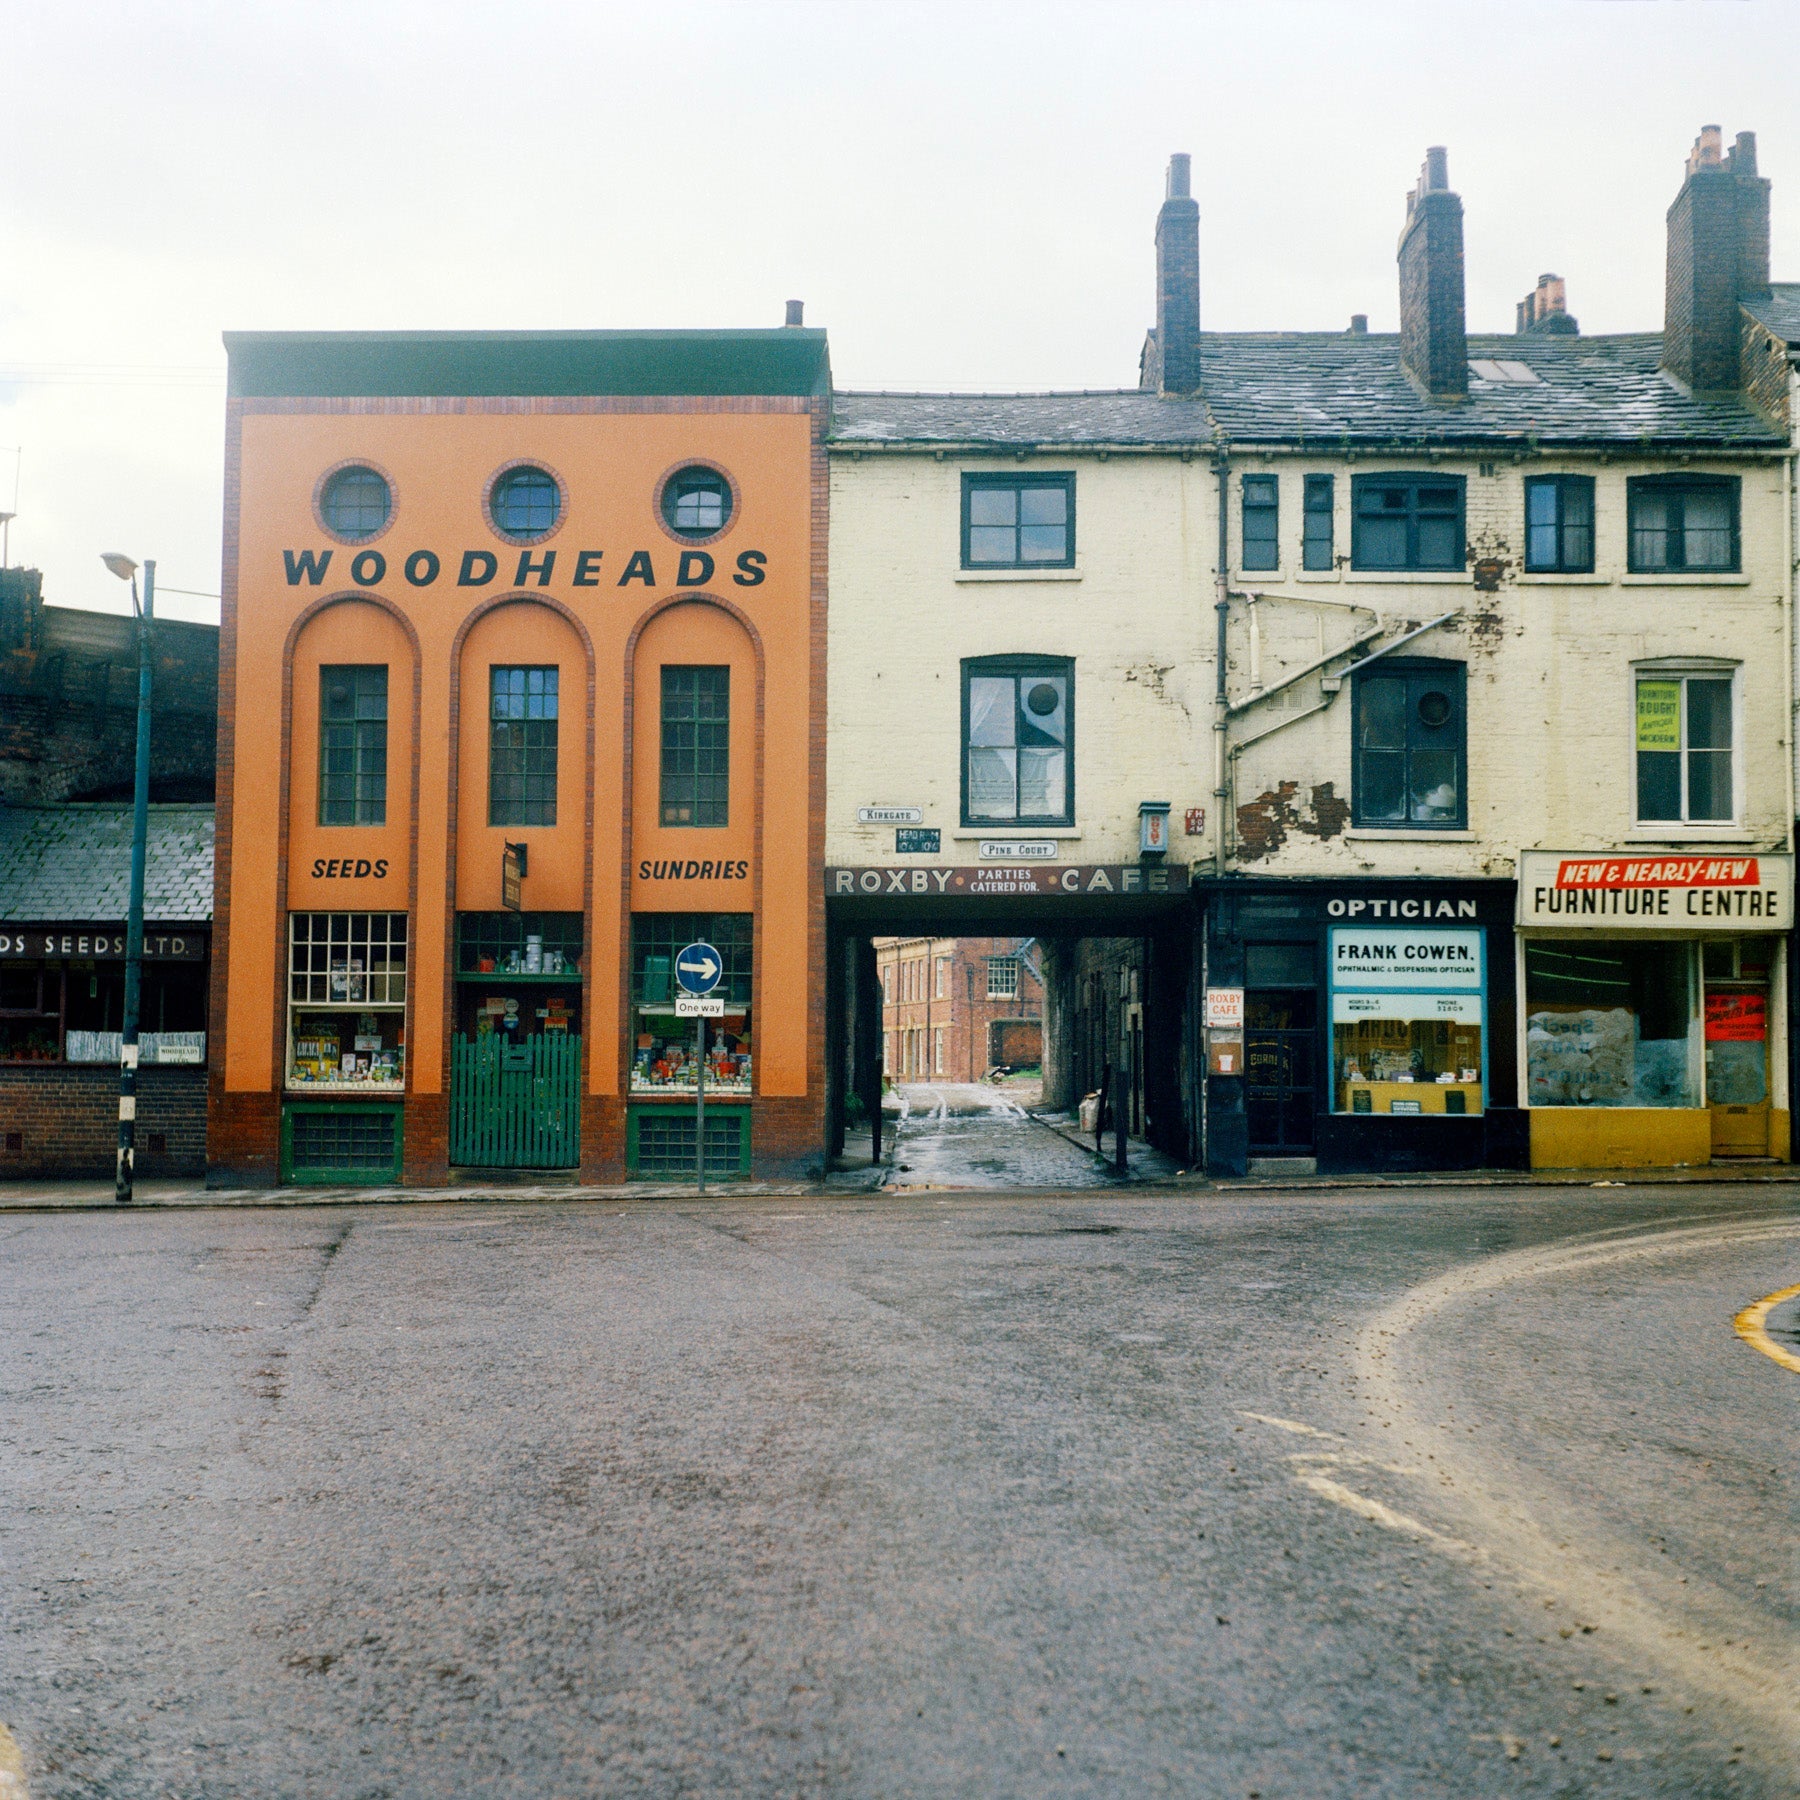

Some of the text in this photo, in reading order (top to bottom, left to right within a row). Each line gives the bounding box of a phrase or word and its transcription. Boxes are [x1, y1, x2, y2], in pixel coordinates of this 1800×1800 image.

[283, 549, 768, 587] WOODHEADS
[311, 859, 389, 879] SEEDS
[638, 860, 749, 880] SUNDRIES
[977, 869, 1031, 880] PARTIES
[1563, 860, 1750, 883] NEW & NEARLY-NEW
[835, 870, 953, 893] ROXBY
[970, 882, 1040, 892] CATERED FOR.
[1061, 869, 1168, 892] CAFE
[1327, 899, 1477, 917] OPTICIAN
[1535, 887, 1778, 916] FURNITURE CENTRE
[45, 935, 123, 953] SEEDS
[143, 937, 190, 955] LTD.
[1338, 945, 1475, 961] FRANK COWEN.
[679, 1003, 721, 1013] One way
[1209, 993, 1241, 1003] ROXBY
[1212, 1005, 1238, 1014] CAFE
